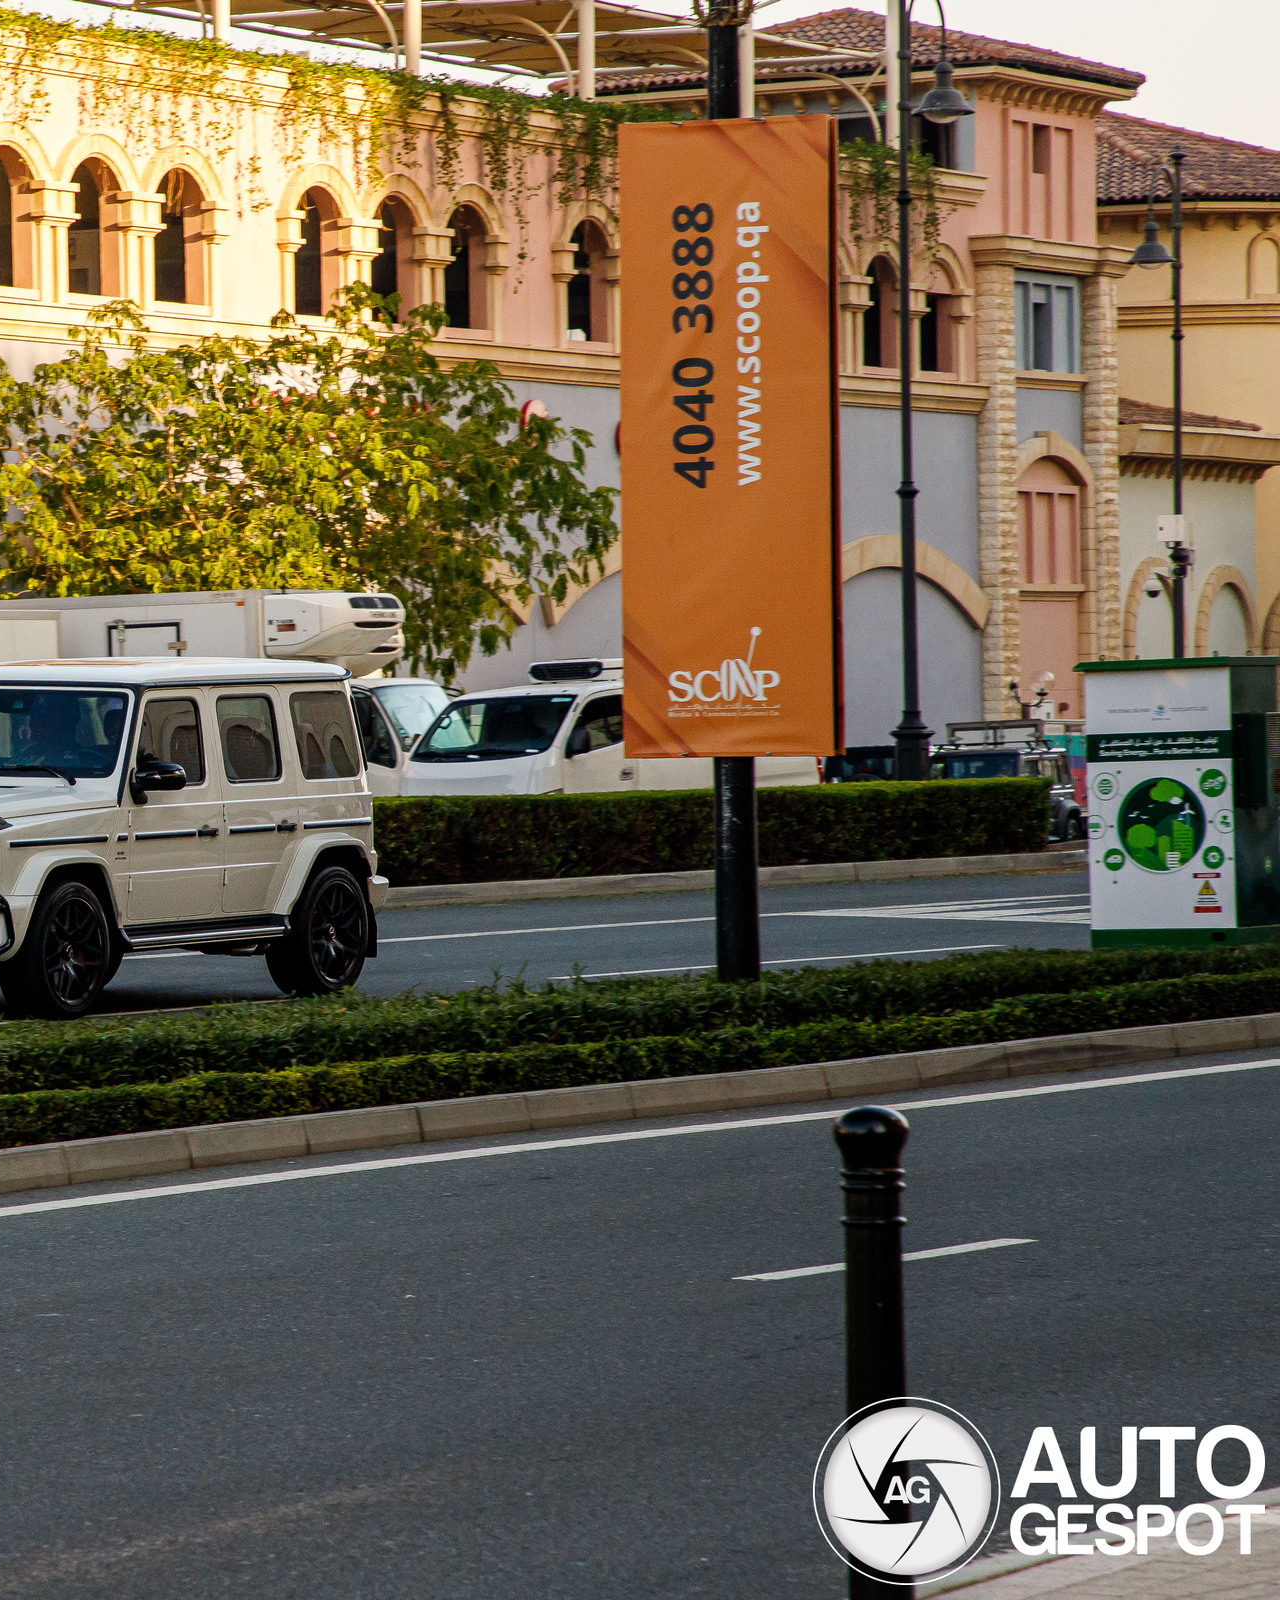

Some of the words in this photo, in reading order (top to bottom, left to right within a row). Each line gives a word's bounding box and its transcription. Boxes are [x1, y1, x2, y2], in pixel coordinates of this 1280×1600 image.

[672, 203, 714, 334] 3888
[736, 202, 770, 486] www.scoop.qa
[672, 357, 714, 488] 4040
